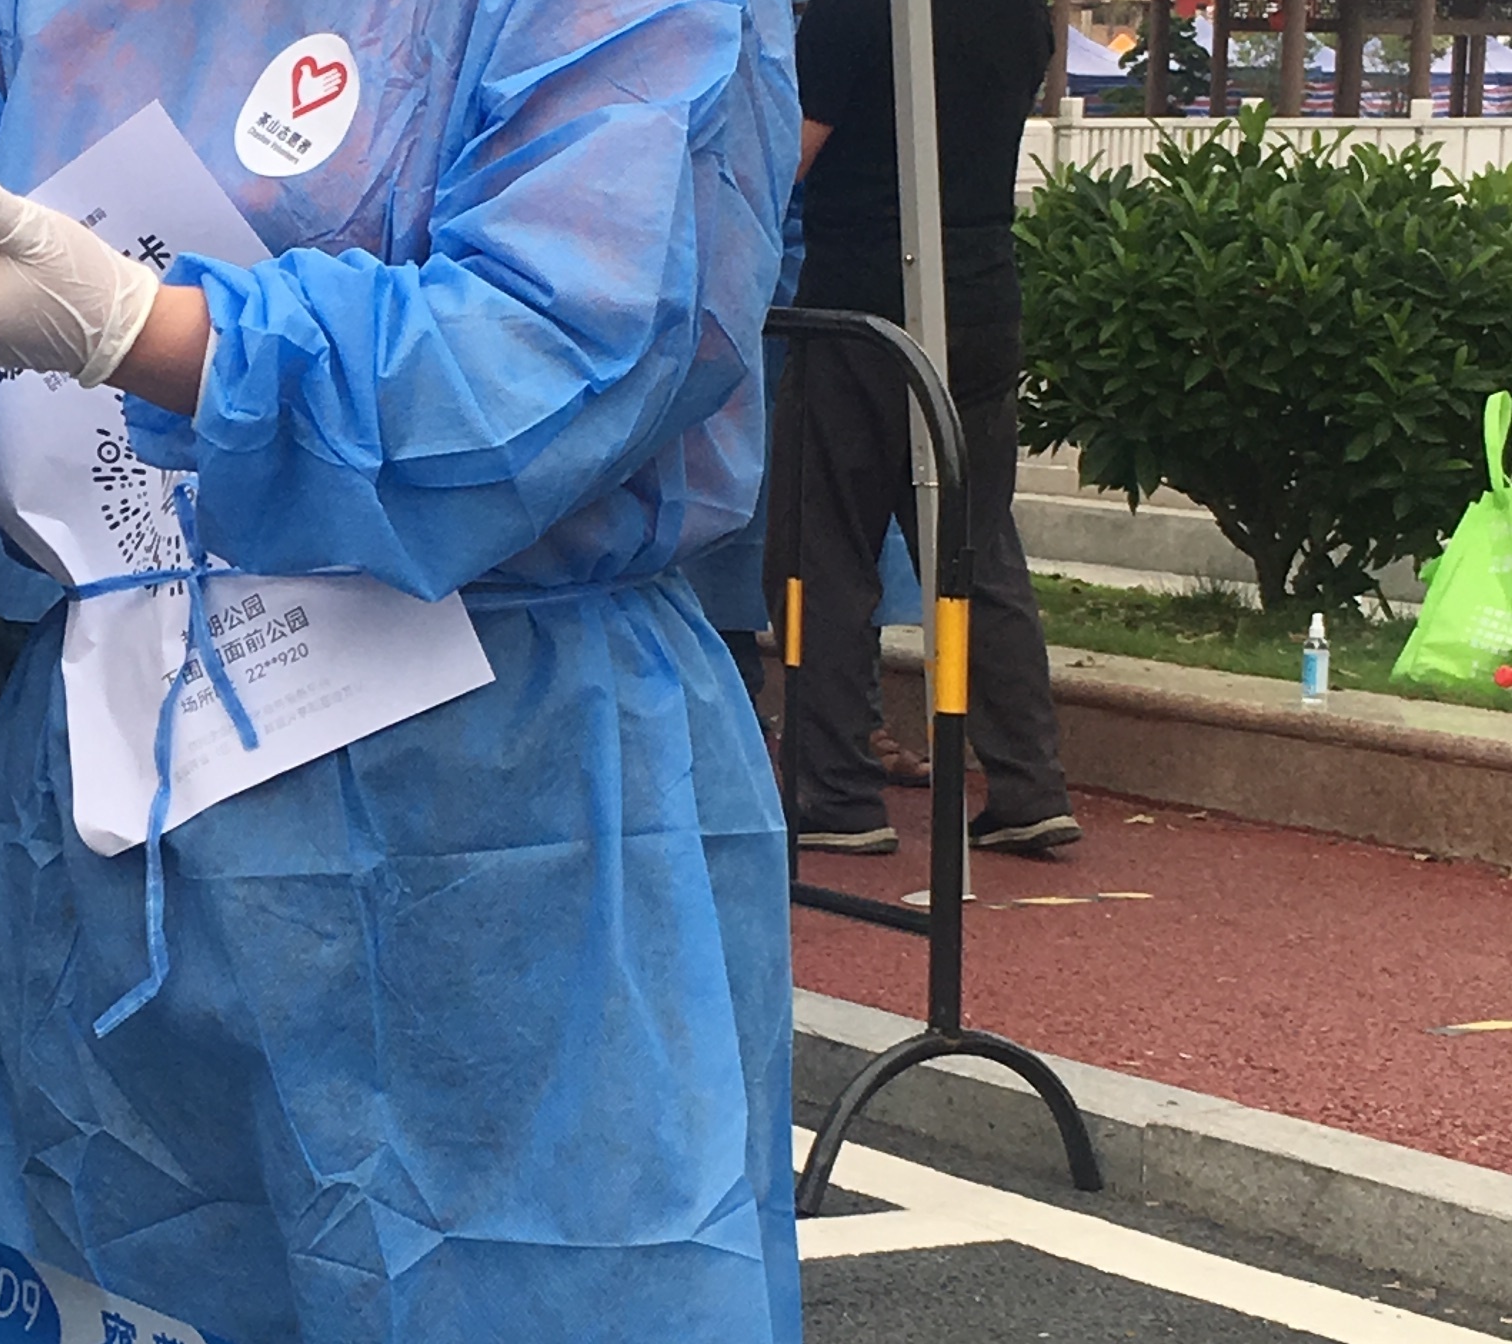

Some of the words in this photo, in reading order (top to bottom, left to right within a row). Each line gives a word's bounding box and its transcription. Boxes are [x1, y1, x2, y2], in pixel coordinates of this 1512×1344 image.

[255, 111, 313, 155] 茶山志愿者
